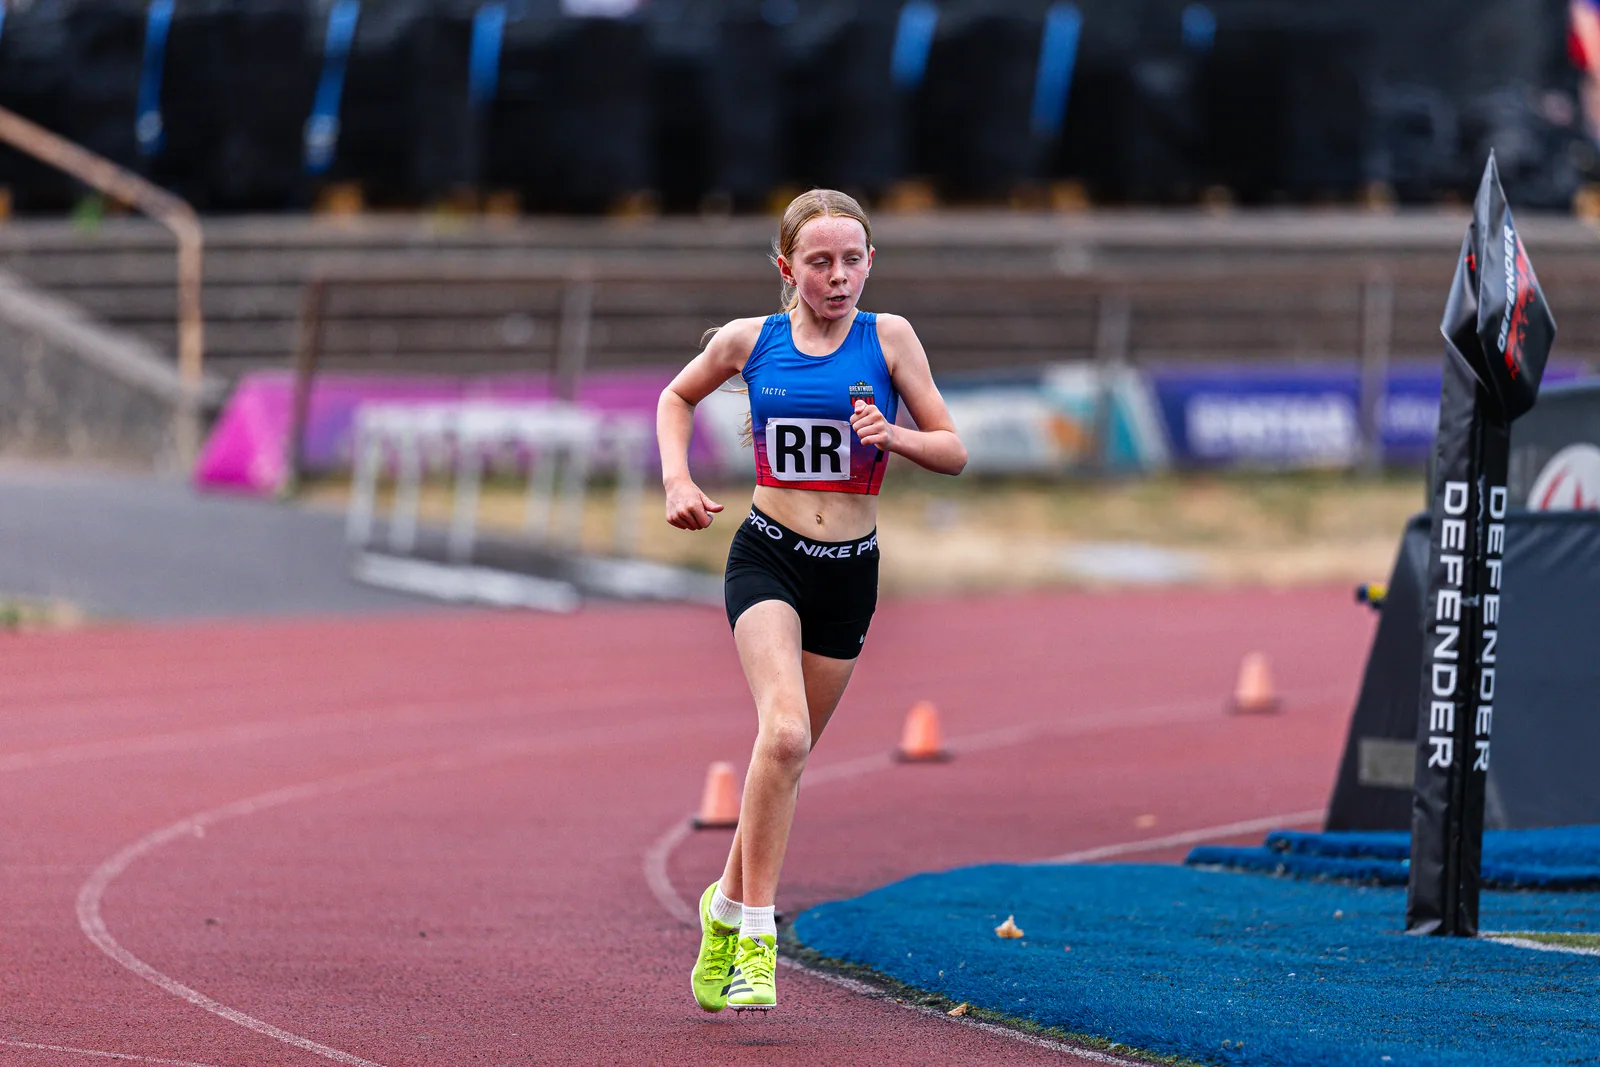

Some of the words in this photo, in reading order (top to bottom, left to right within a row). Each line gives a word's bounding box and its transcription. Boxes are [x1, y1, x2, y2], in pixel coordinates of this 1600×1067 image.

[1497, 225, 1514, 353] DEFENDER
[761, 387, 787, 396] TACTIC
[775, 424, 842, 473] RR
[747, 510, 783, 540] PRO
[793, 540, 853, 559] NIKE
[1428, 481, 1469, 769] DEFENDER
[1473, 485, 1508, 772] DEFENDER
